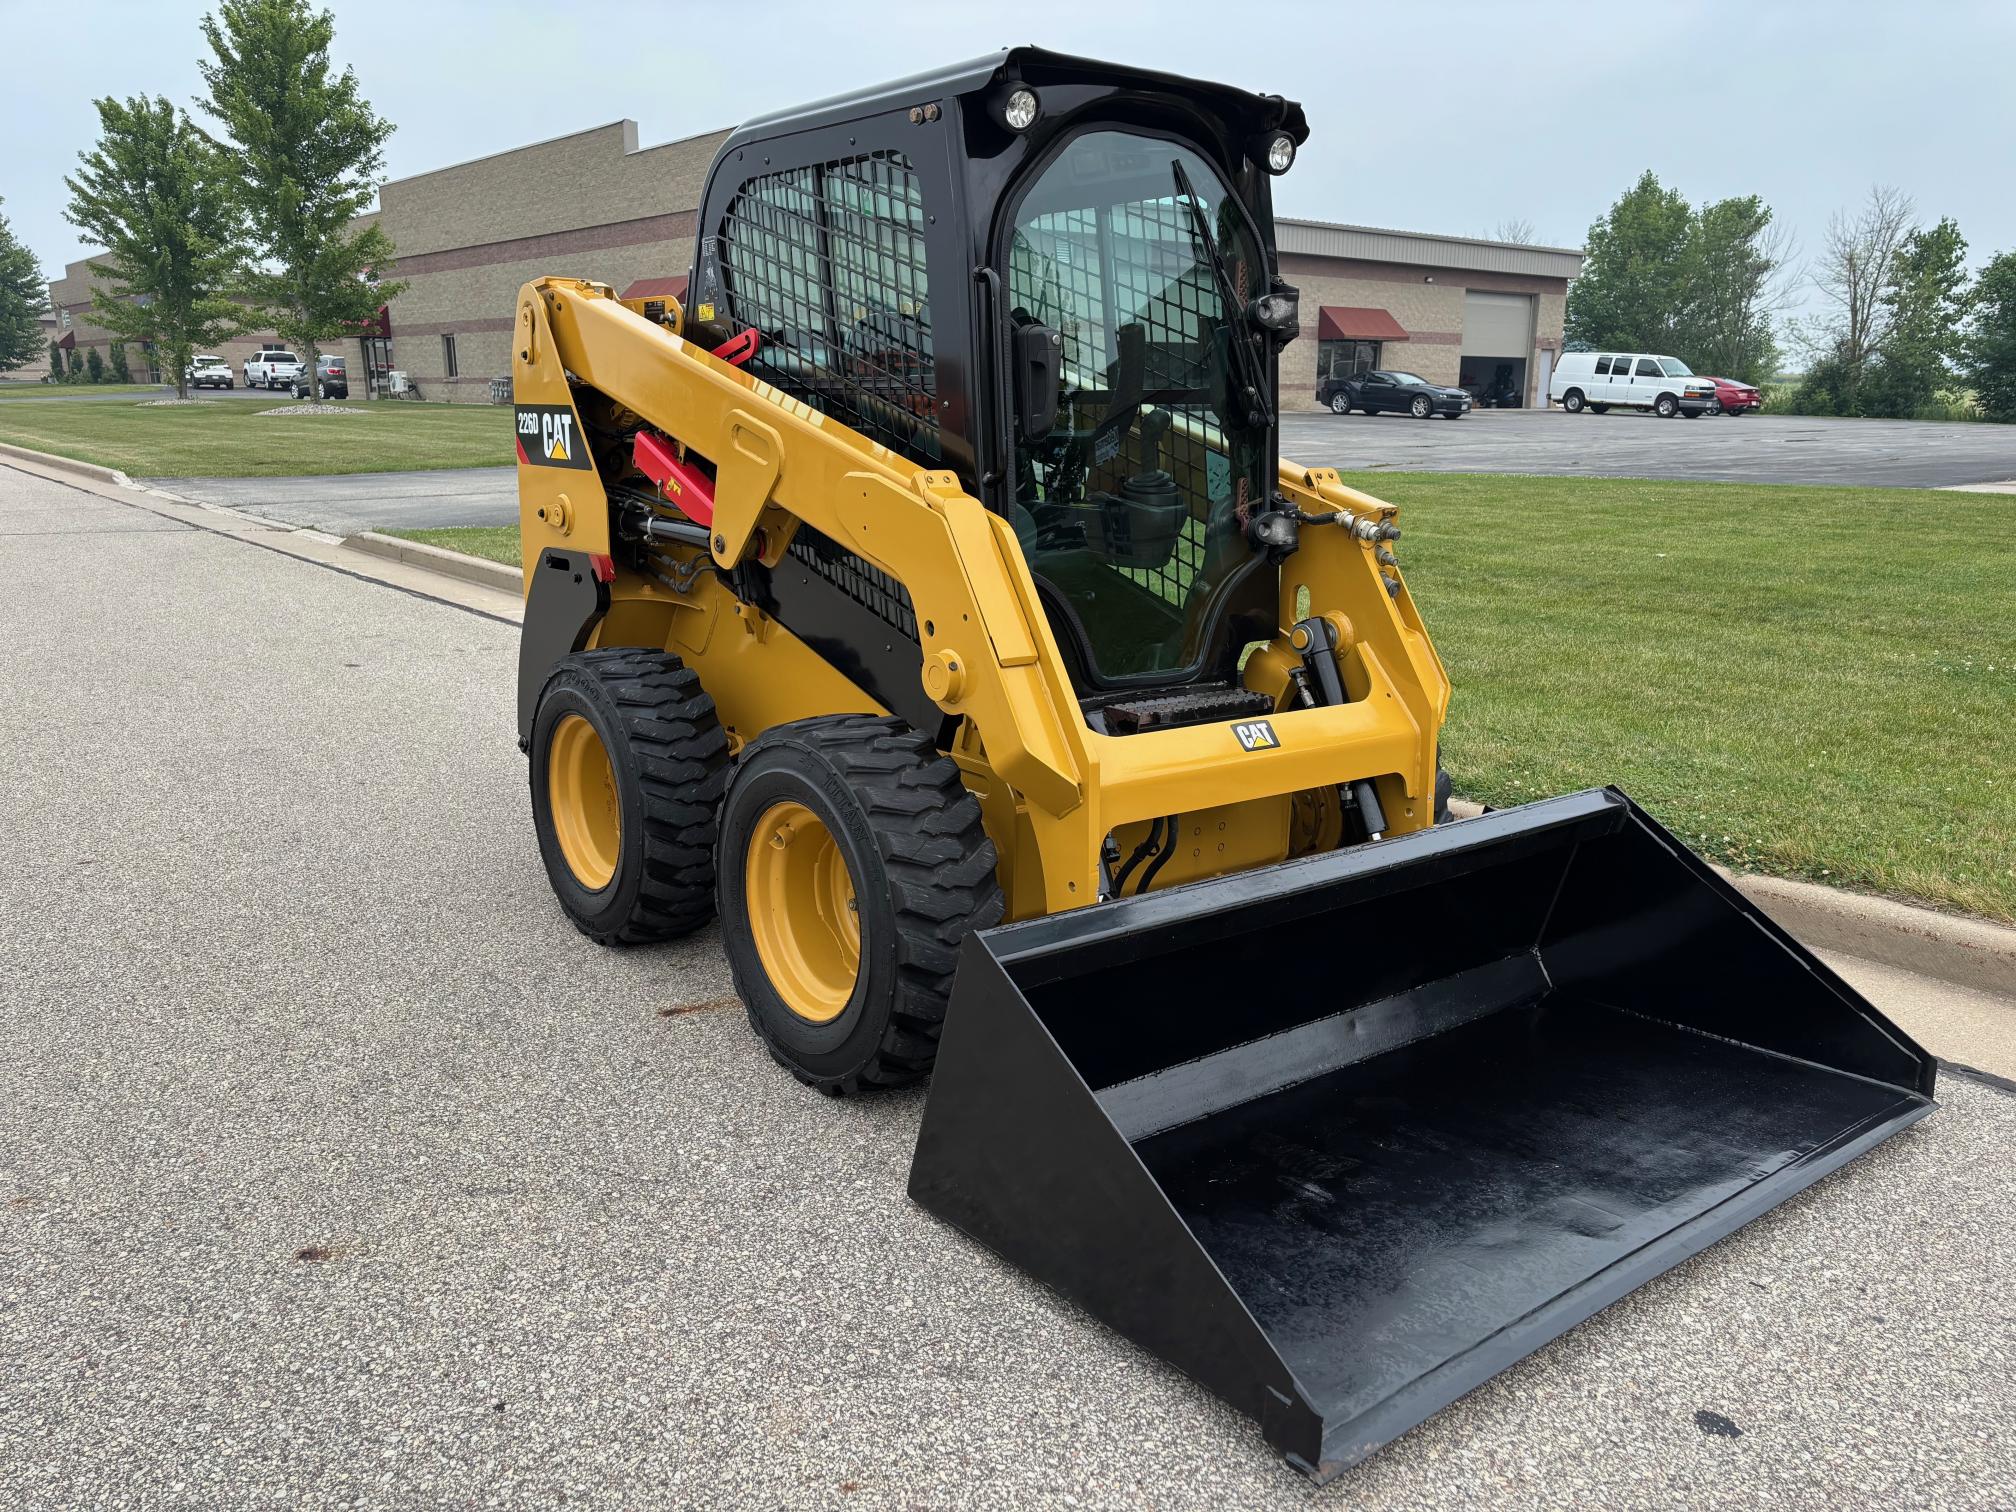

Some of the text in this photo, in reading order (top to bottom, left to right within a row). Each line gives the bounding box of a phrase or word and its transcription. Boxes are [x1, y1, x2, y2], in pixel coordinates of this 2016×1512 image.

[518, 412, 572, 460] 226D CAT
[1236, 722, 1275, 749] CAT
